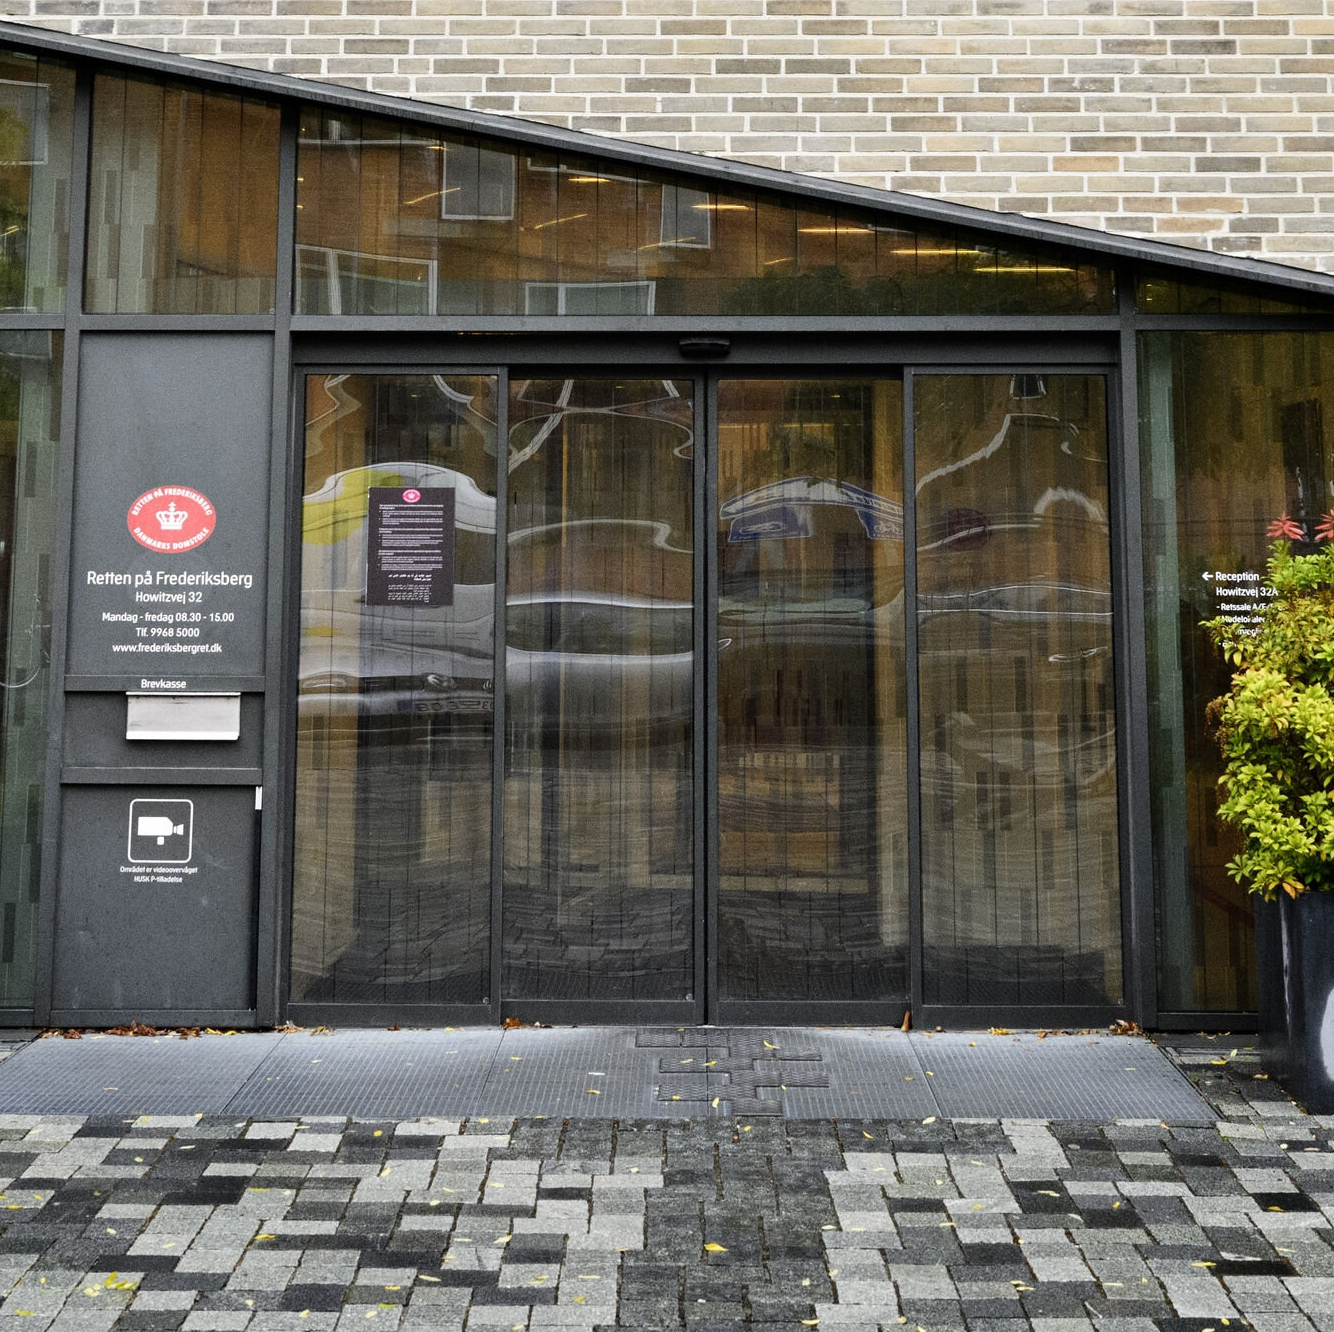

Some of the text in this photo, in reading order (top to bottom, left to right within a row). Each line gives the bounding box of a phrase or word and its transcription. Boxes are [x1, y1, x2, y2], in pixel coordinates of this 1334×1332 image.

[131, 488, 212, 516] RETTEN PÅ FREDERIKSBERG
[133, 527, 209, 550] DANMARKS DOMSTOLE
[87, 571, 252, 588] Retten på Frederiksberg
[1216, 572, 1259, 582] Reception
[136, 592, 202, 604] Howitzvej 32
[1216, 587, 1279, 598] Howitzvej 32A
[1221, 603, 1251, 611] Retssale
[102, 612, 138, 623] Mandag
[145, 612, 173, 623] fredag
[176, 613, 201, 621] 08.30
[210, 613, 234, 622] 15.00
[136, 628, 199, 637] Tlf. 9968 5000
[112, 643, 222, 654] www.frederiksbergret.dk
[141, 679, 186, 688] Brevkasse
